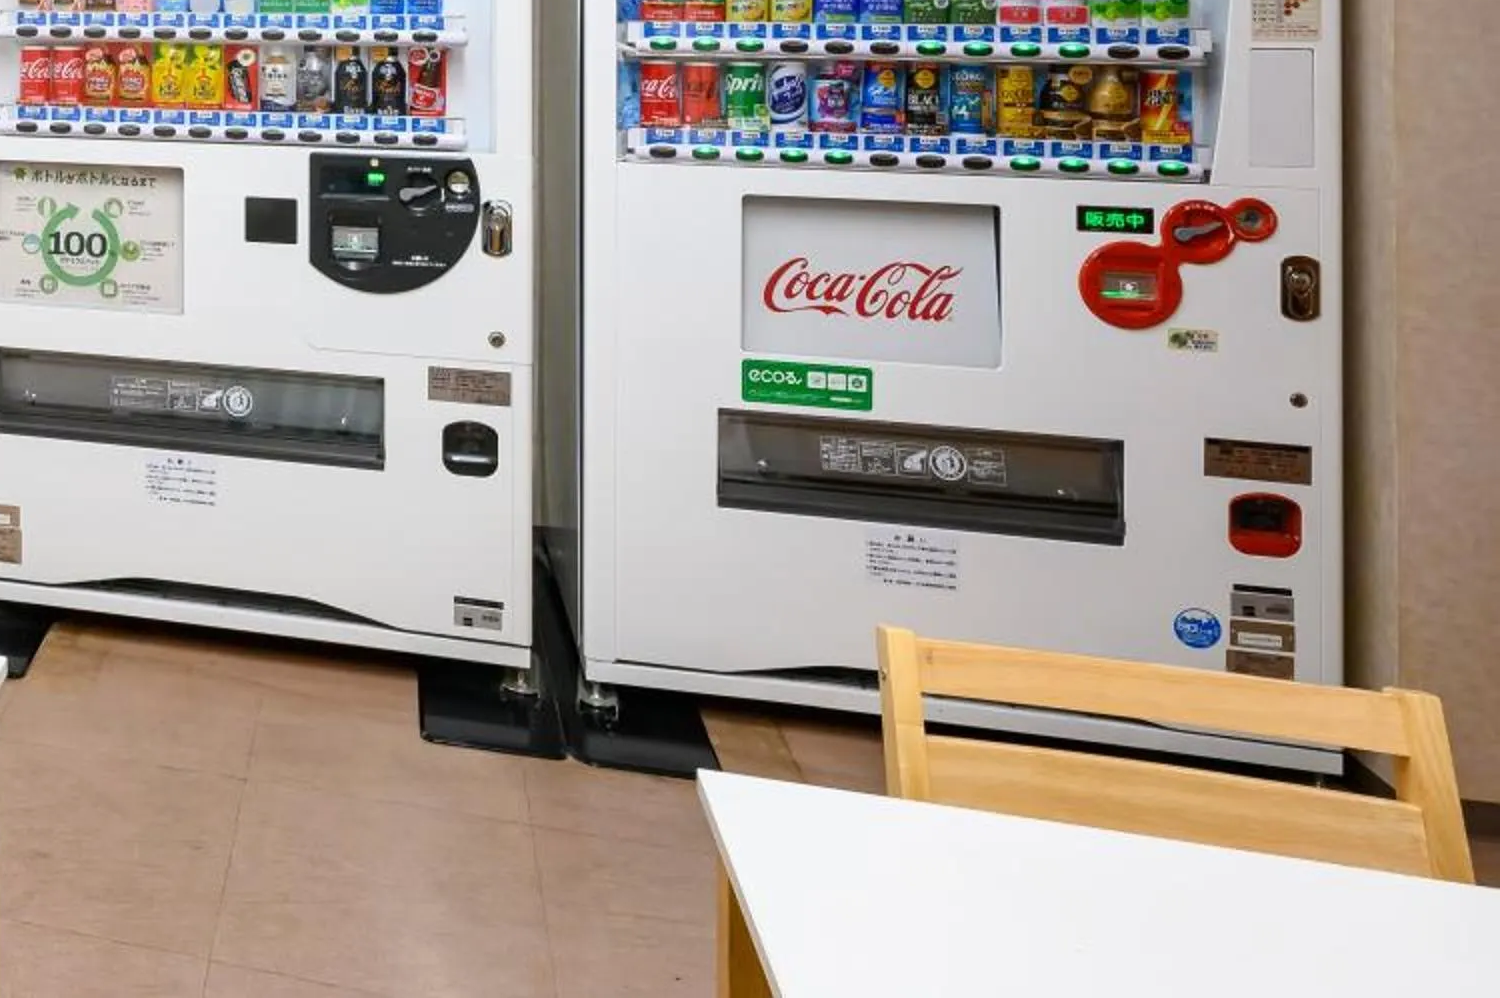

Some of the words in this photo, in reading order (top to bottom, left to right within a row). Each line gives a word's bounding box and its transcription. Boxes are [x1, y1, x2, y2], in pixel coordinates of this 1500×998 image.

[31, 169, 158, 189] ボトルがボトルになるまで
[1084, 210, 1146, 230] 販売中
[47, 231, 108, 258] 100
[763, 256, 964, 323] Coca-Cola
